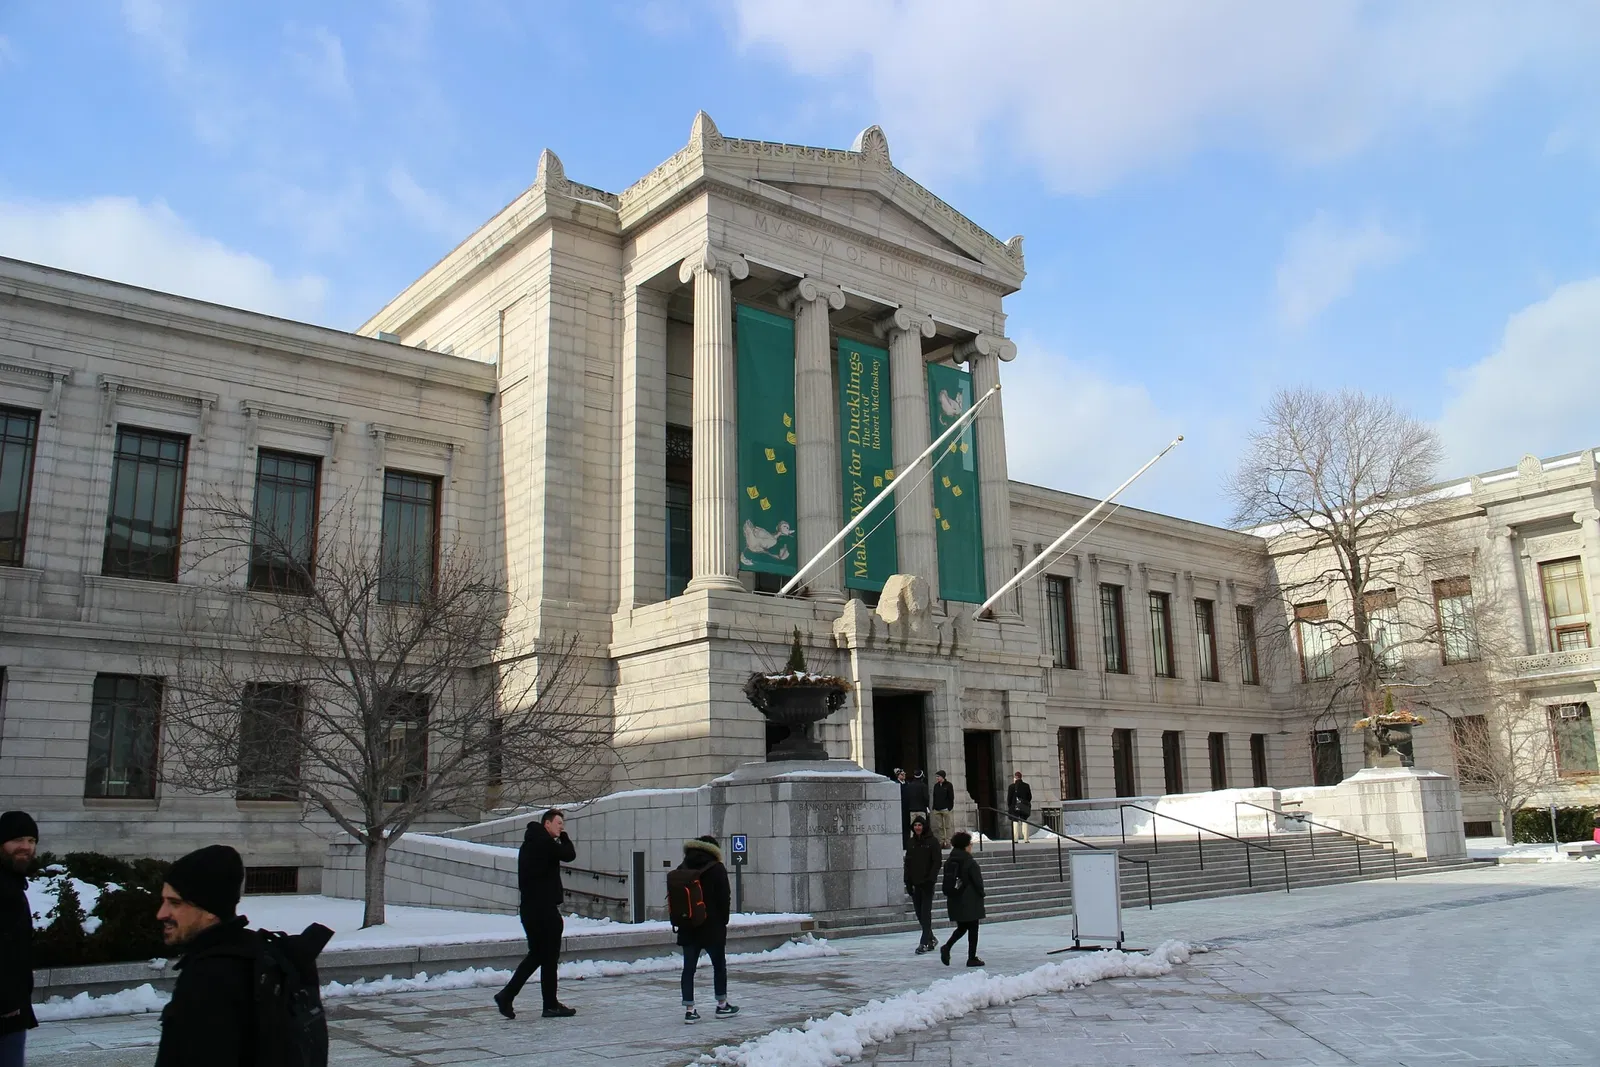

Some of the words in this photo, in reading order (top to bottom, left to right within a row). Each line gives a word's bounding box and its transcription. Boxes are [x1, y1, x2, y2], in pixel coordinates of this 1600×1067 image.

[754, 212, 835, 254] MVSEVM
[846, 246, 868, 264] OF
[879, 256, 919, 283] FINE
[929, 275, 969, 299] ARTS
[846, 352, 864, 446] Ducklings
[861, 393, 870, 407] of
[871, 358, 881, 413] McCloskey
[862, 409, 870, 426] Art
[861, 427, 870, 448] The
[872, 415, 881, 450] Robert
[848, 449, 862, 478] for
[850, 480, 867, 521] Way
[853, 526, 869, 578] Make
[798, 802, 820, 812] BANK
[822, 802, 833, 811] OF
[835, 802, 867, 811] AMERICA
[869, 802, 892, 811] PLAZA
[832, 813, 845, 822] ON
[847, 813, 862, 822] THE
[807, 825, 838, 834] AVENUE
[839, 824, 849, 834] OF
[851, 824, 865, 833] THE
[866, 824, 885, 833] ARTS
